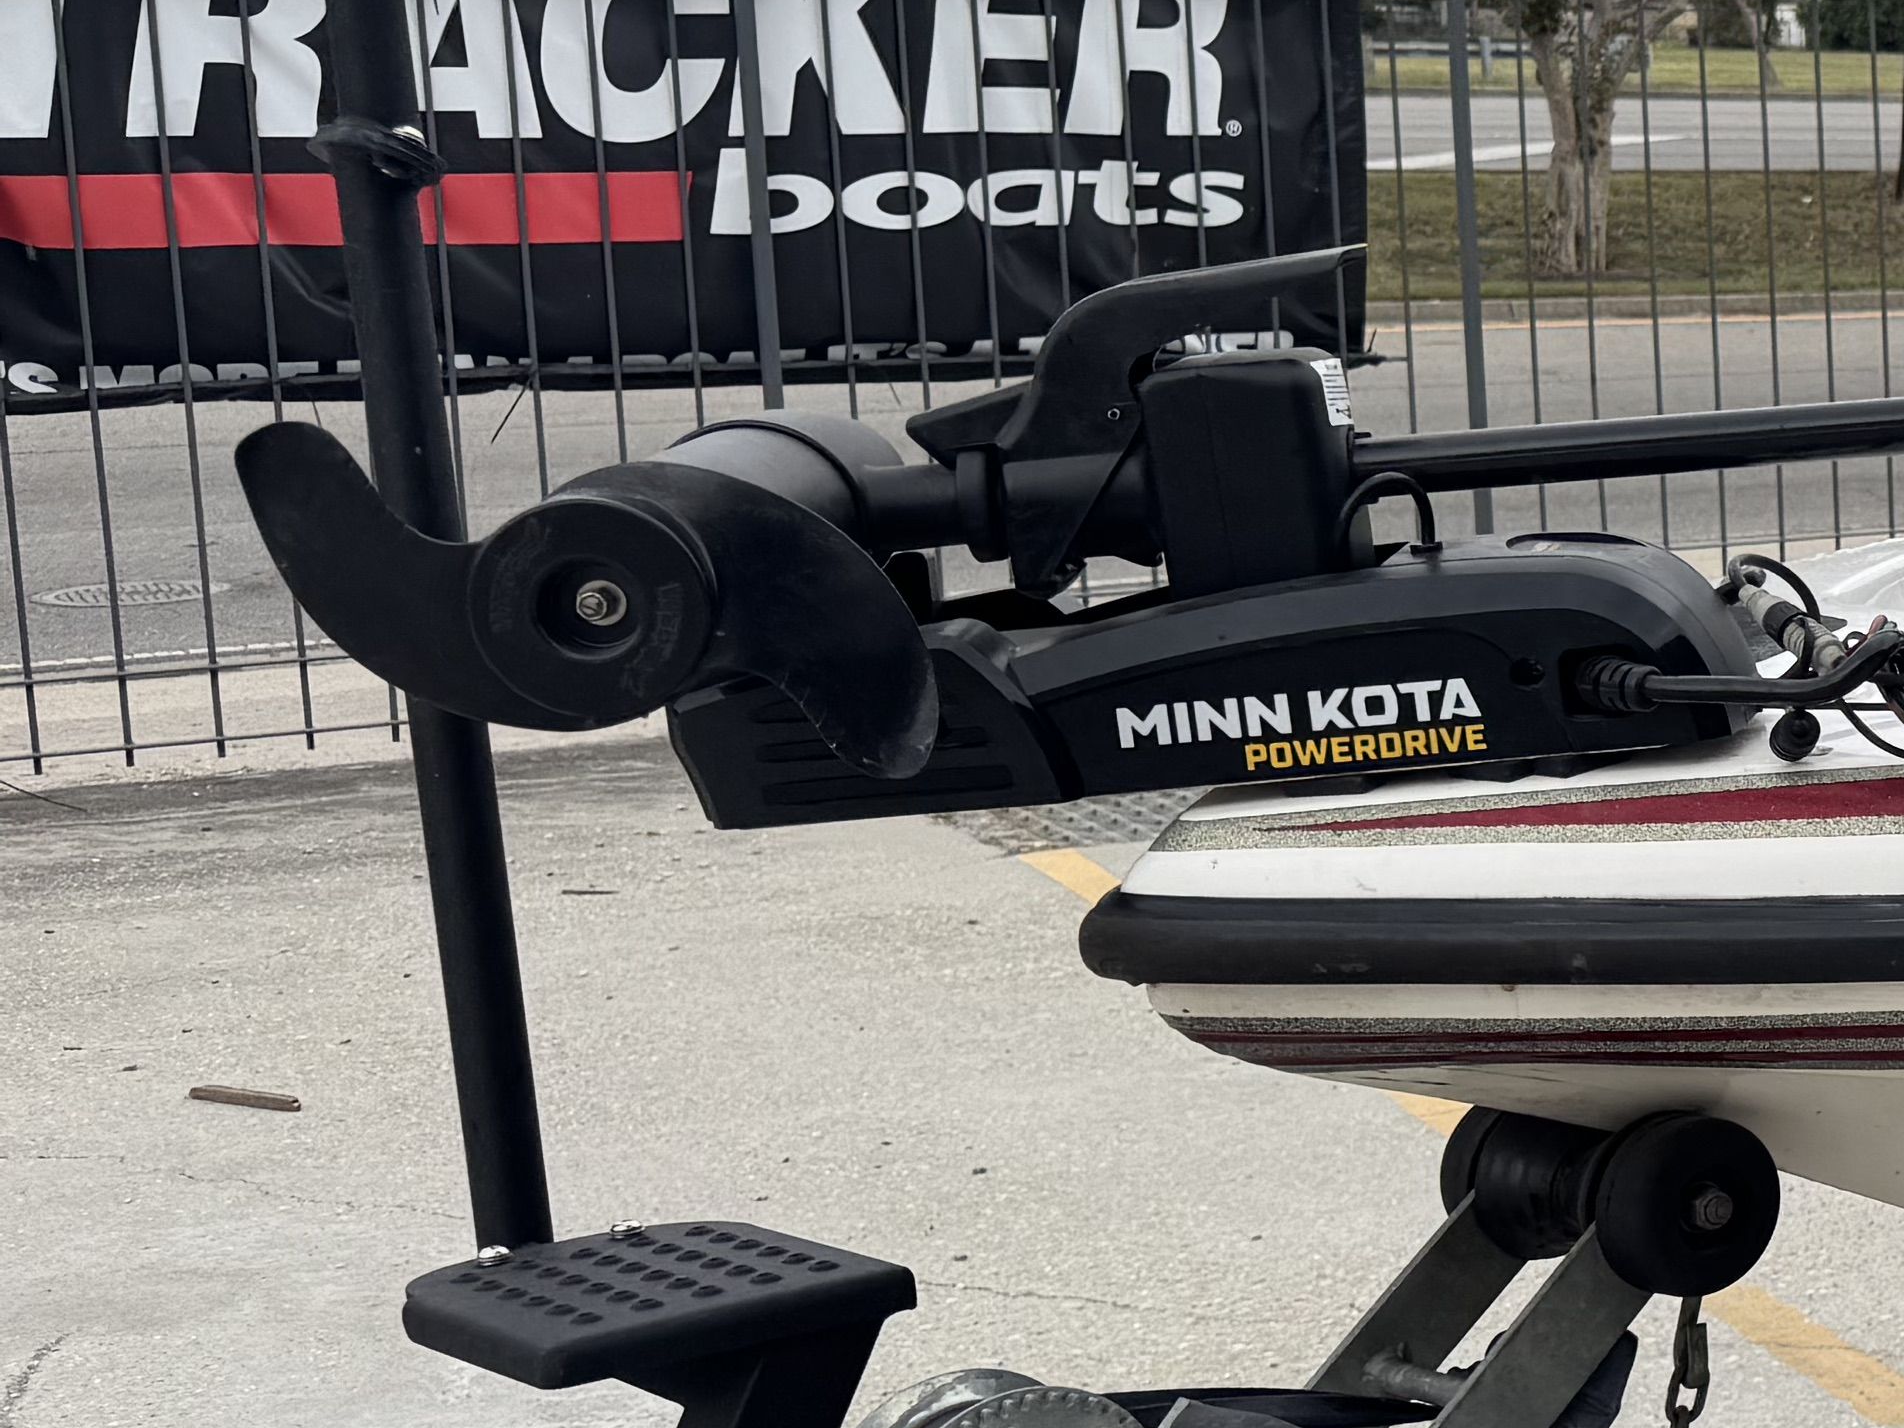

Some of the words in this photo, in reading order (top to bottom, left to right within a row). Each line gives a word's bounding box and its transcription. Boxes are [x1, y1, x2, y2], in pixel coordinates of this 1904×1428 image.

[709, 147, 1245, 236] boats
[1115, 693, 1293, 749] MINN
[1307, 677, 1483, 732] KOTA
[1244, 724, 1489, 771] POWERDRIVE
